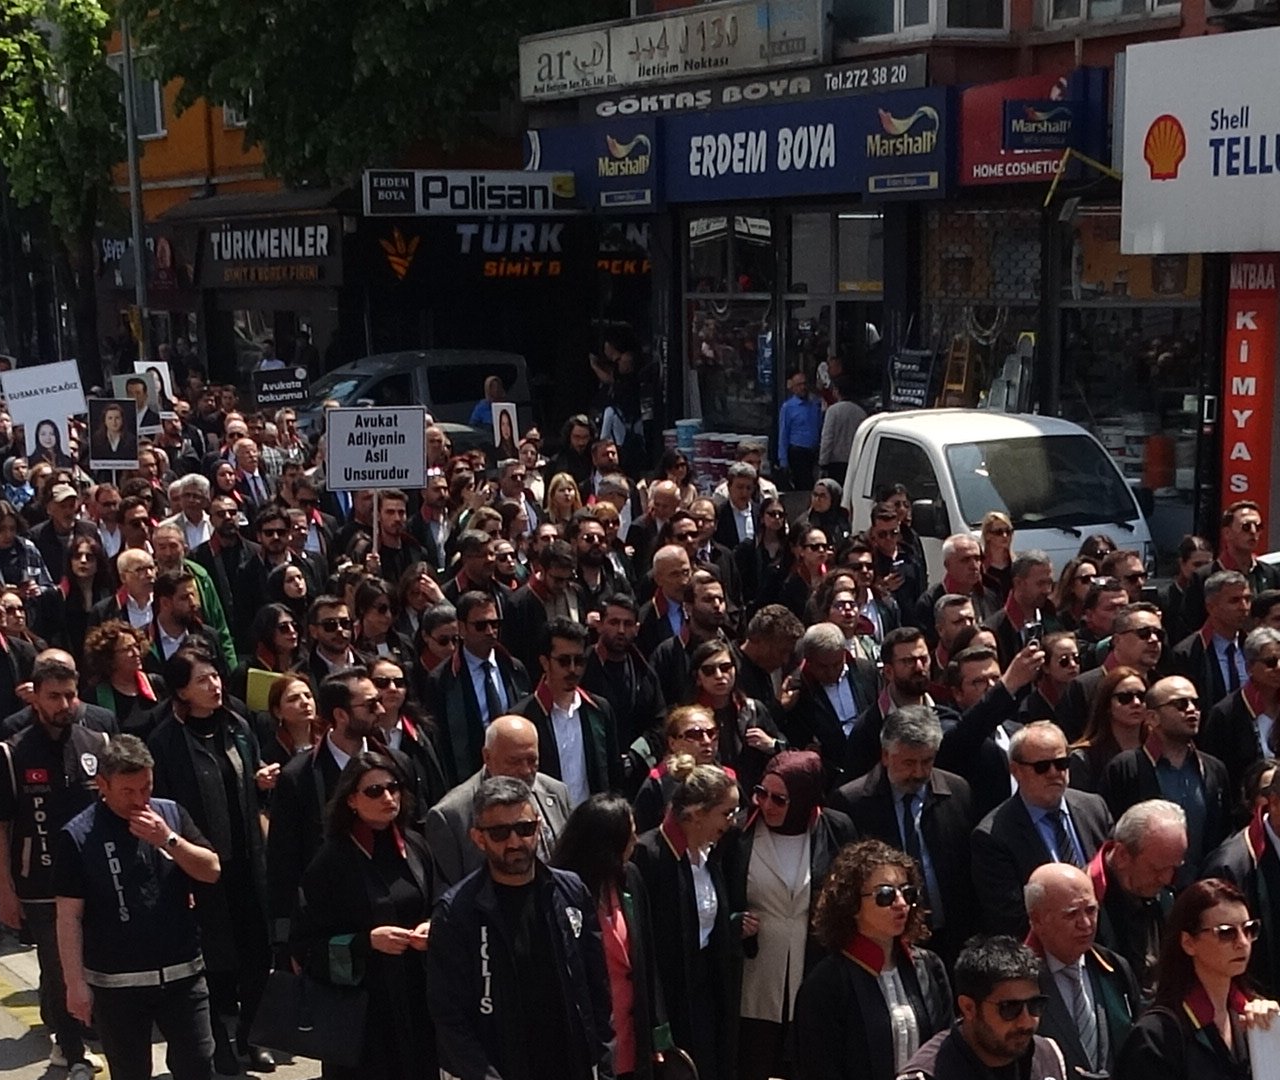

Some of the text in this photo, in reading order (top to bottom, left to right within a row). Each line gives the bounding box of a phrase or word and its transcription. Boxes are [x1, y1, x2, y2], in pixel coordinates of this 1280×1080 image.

[596, 90, 713, 118] GÖKTAŞ
[722, 77, 811, 103] BOYA
[871, 66, 888, 87] 38
[891, 64, 908, 85] 20
[1012, 118, 1071, 134] Marshall
[1210, 105, 1250, 131] Shell
[689, 122, 836, 179] ERDEM BOYA
[866, 130, 935, 158] Marshall
[598, 156, 649, 178] Marshall
[972, 162, 1004, 179] HOME
[373, 177, 410, 189] ERDEM
[421, 175, 550, 211] Polisan
[377, 190, 406, 201] BOYA
[210, 223, 330, 261] TÜRKMENLER
[456, 216, 565, 254] TÜRK
[1230, 263, 1276, 290] MATBAA
[262, 380, 302, 392] Avukata
[257, 392, 303, 403] Dokunma
[1229, 310, 1258, 493] KİMYAS
[354, 414, 398, 428] Avukat
[347, 431, 406, 449] Adliyenin
[364, 449, 388, 464] Asli
[343, 465, 410, 482] Unsurudur
[33, 796, 53, 867] POLİS
